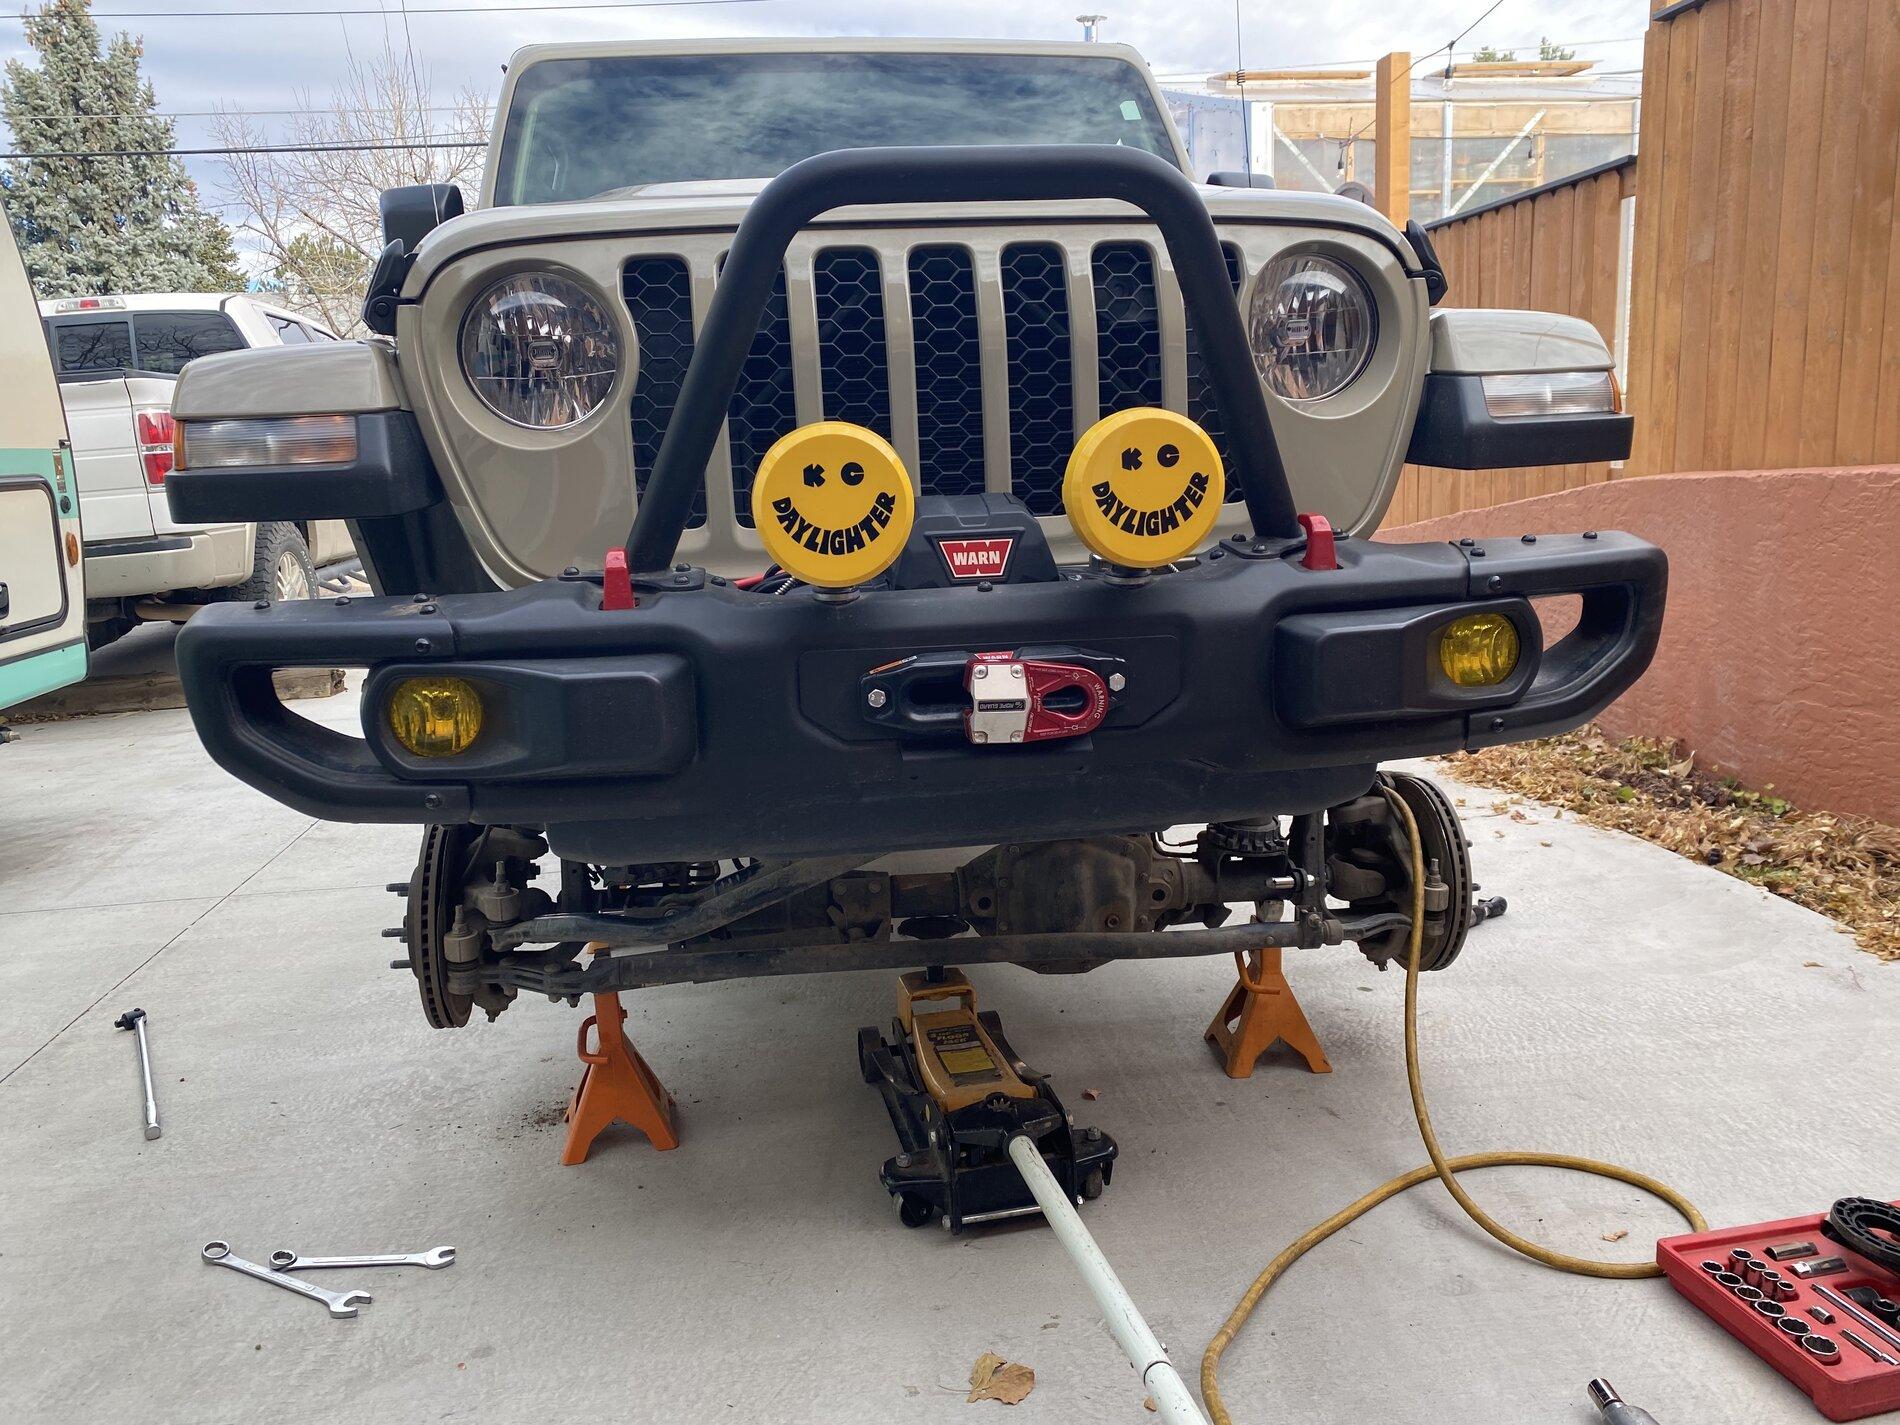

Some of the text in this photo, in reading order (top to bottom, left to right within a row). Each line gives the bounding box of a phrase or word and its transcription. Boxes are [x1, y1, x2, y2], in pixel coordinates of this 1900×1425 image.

[1121, 447, 1143, 471] K
[802, 463, 826, 488] K
[1091, 471, 1210, 537] DAYLIGHTER
[771, 491, 896, 556] DAYLIGHTER
[952, 550, 1001, 566] WARN
[1094, 682, 1105, 719] WARNING
